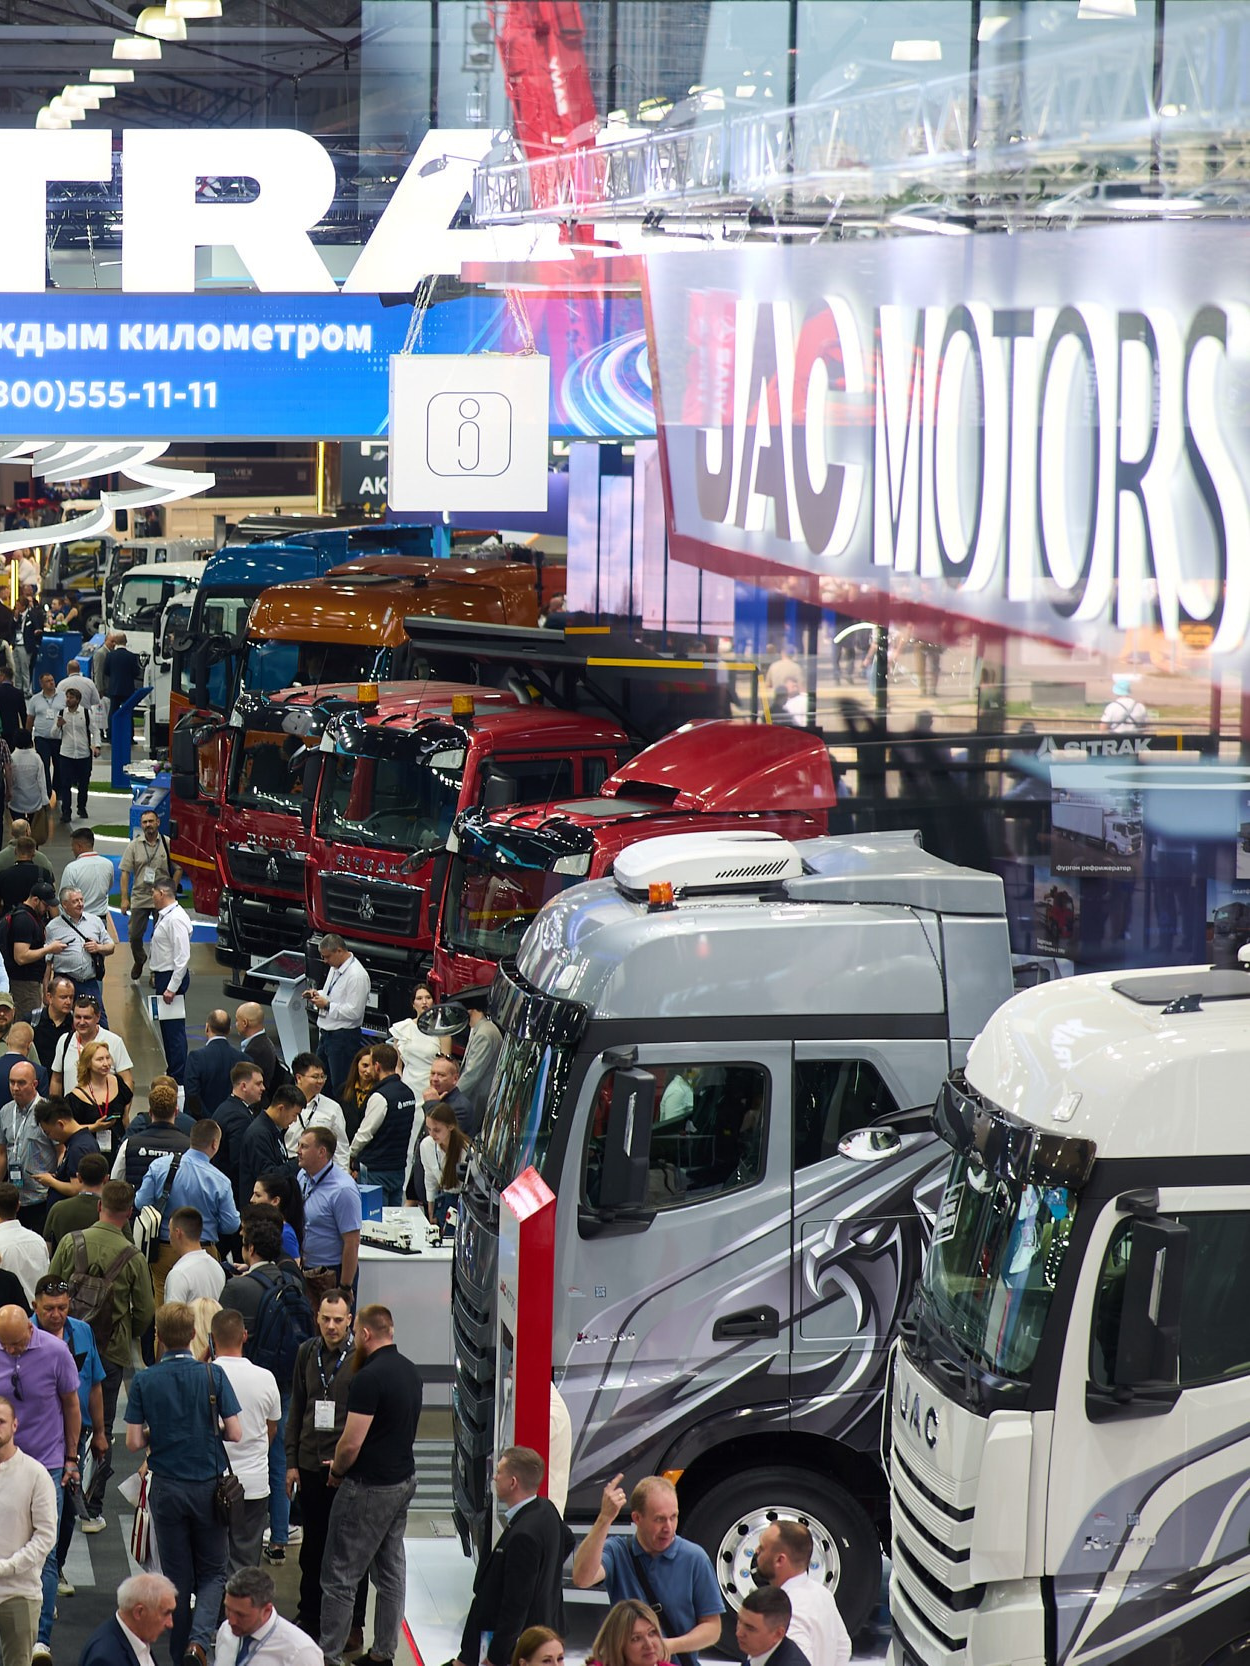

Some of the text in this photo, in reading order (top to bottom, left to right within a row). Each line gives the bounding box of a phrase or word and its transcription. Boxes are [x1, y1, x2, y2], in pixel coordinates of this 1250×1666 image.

[120, 324, 371, 359] километром
[696, 294, 1250, 655] JAC MOTORS
[1063, 737, 1153, 757] SITRAK
[900, 1381, 940, 1450] JAC
